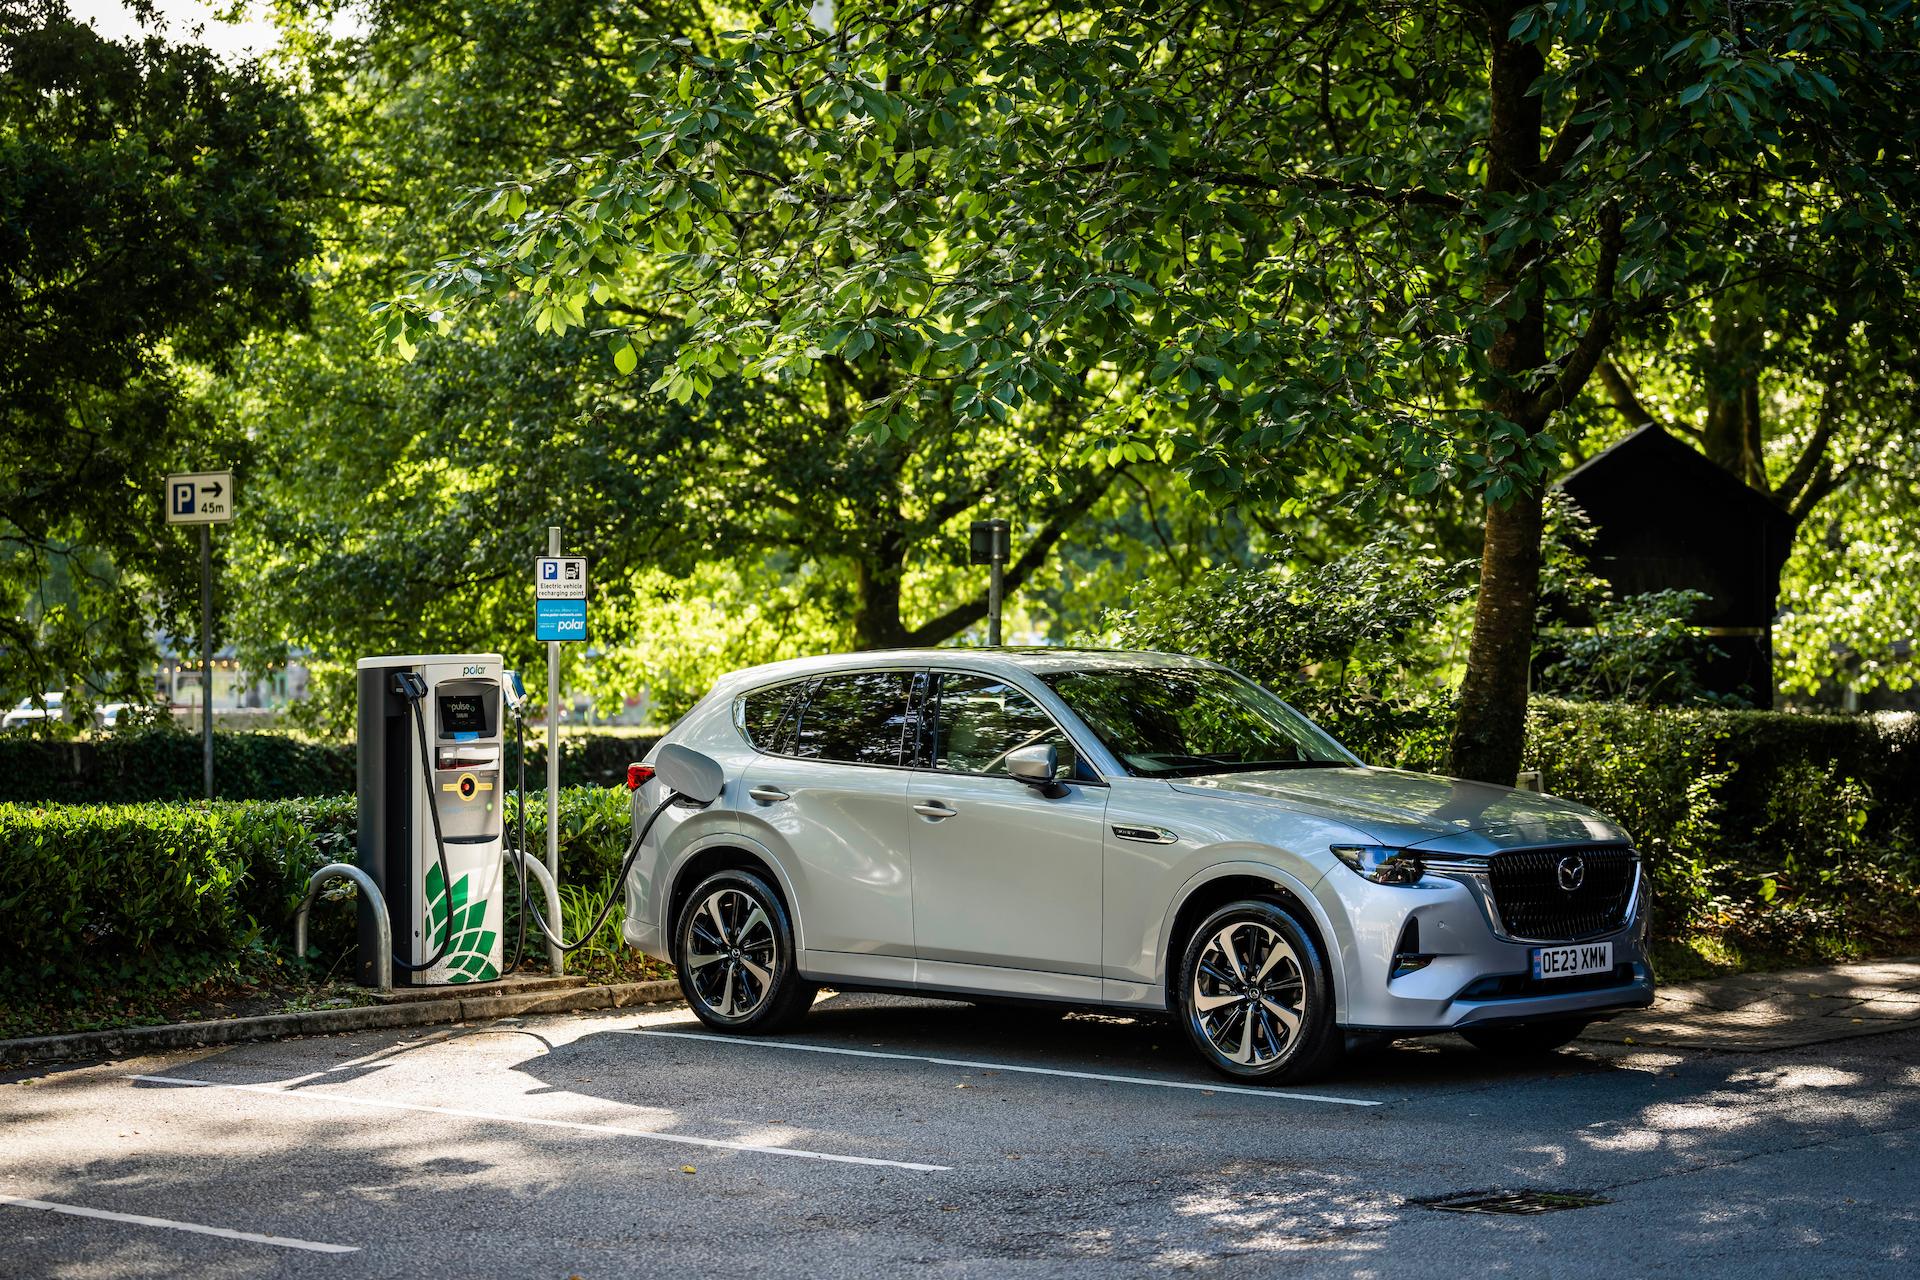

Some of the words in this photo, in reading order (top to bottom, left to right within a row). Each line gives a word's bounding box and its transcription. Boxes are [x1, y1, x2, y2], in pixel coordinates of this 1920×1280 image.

[177, 485, 192, 512] P
[201, 502, 224, 513] 45m
[544, 563, 556, 578] P
[557, 618, 584, 632] polar
[463, 665, 487, 677] polar
[451, 701, 470, 712] pulse
[1543, 949, 1577, 973] OE23
[1581, 946, 1606, 970] XMW
